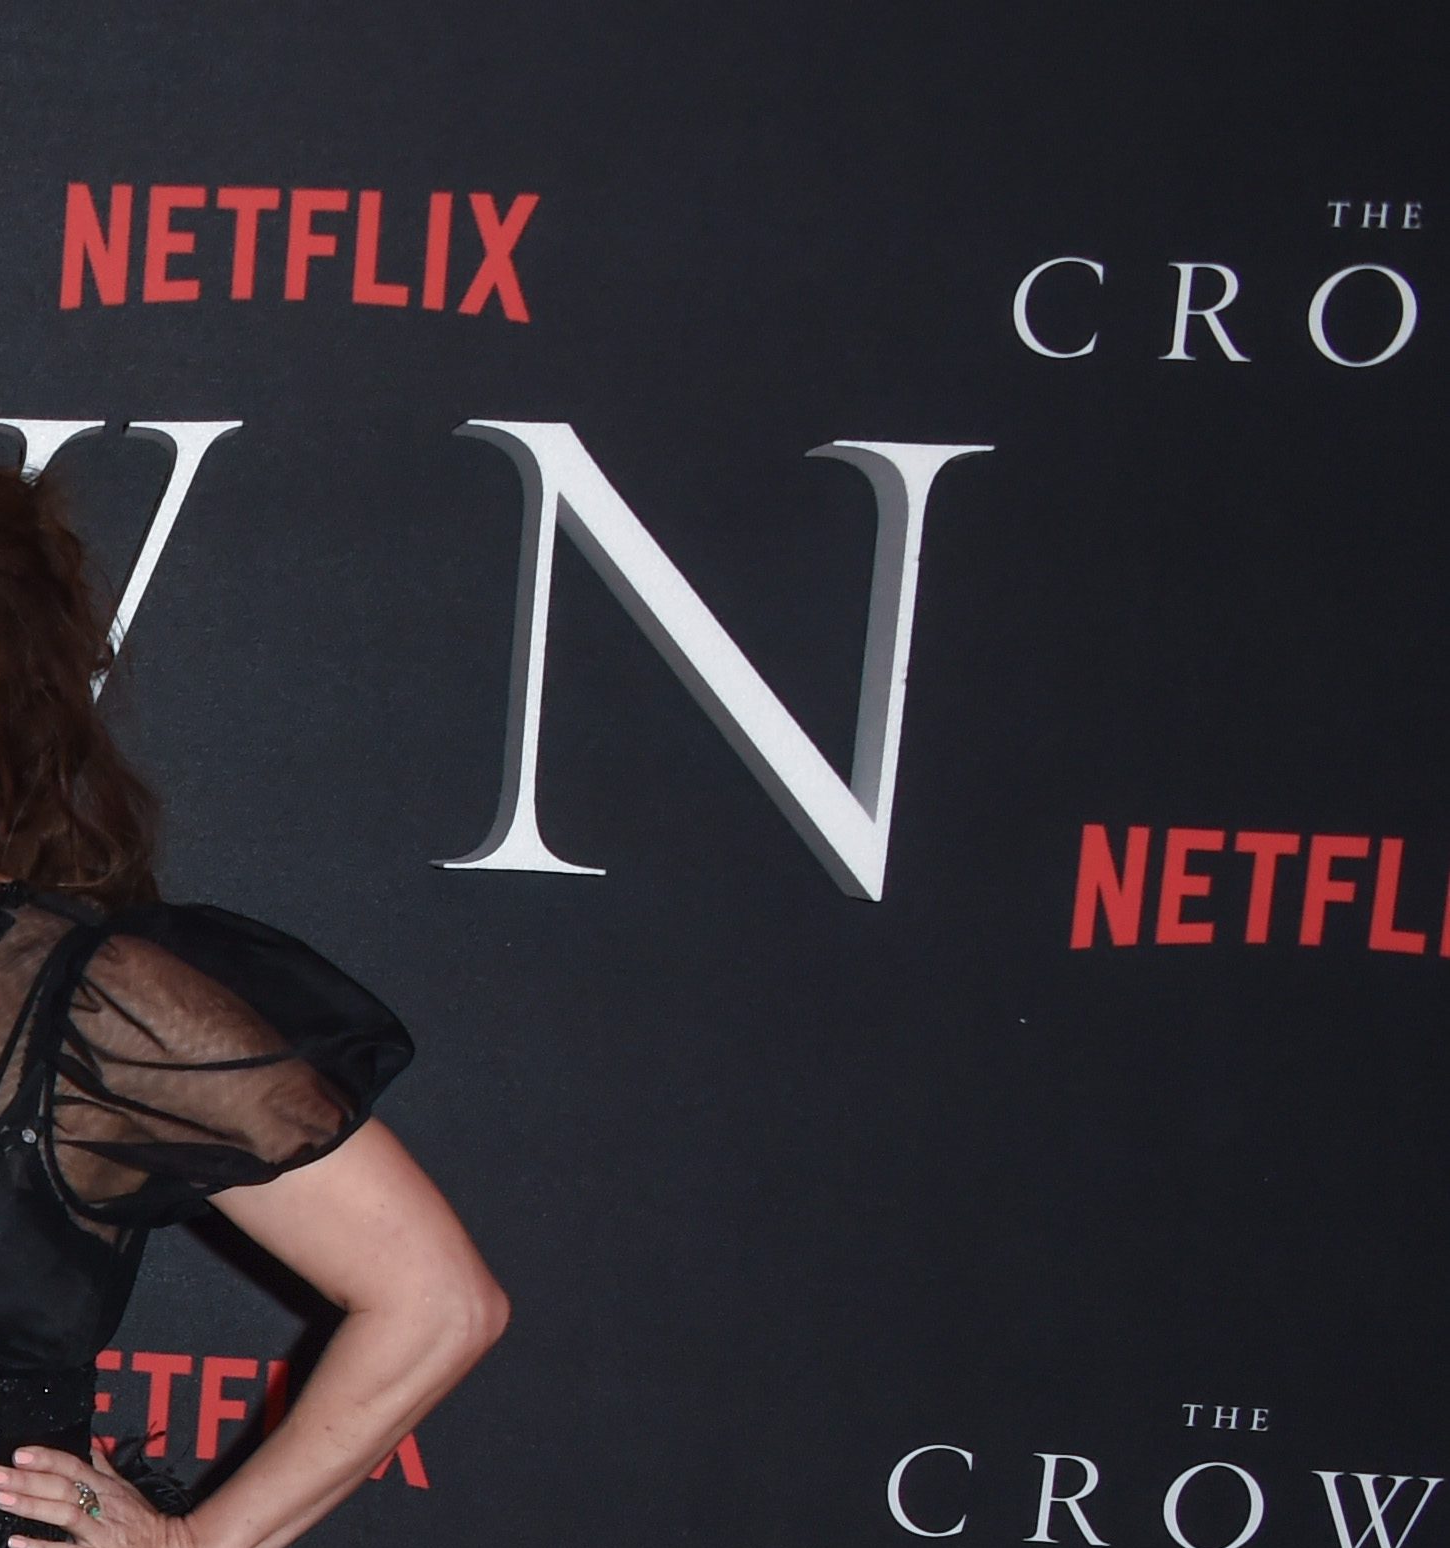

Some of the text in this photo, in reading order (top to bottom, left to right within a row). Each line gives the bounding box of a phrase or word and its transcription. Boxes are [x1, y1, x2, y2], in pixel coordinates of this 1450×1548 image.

[1327, 201, 1423, 229] THE
[59, 181, 541, 324] NETFLIX
[1013, 257, 1420, 368] CRO
[1182, 1403, 1271, 1432] THE
